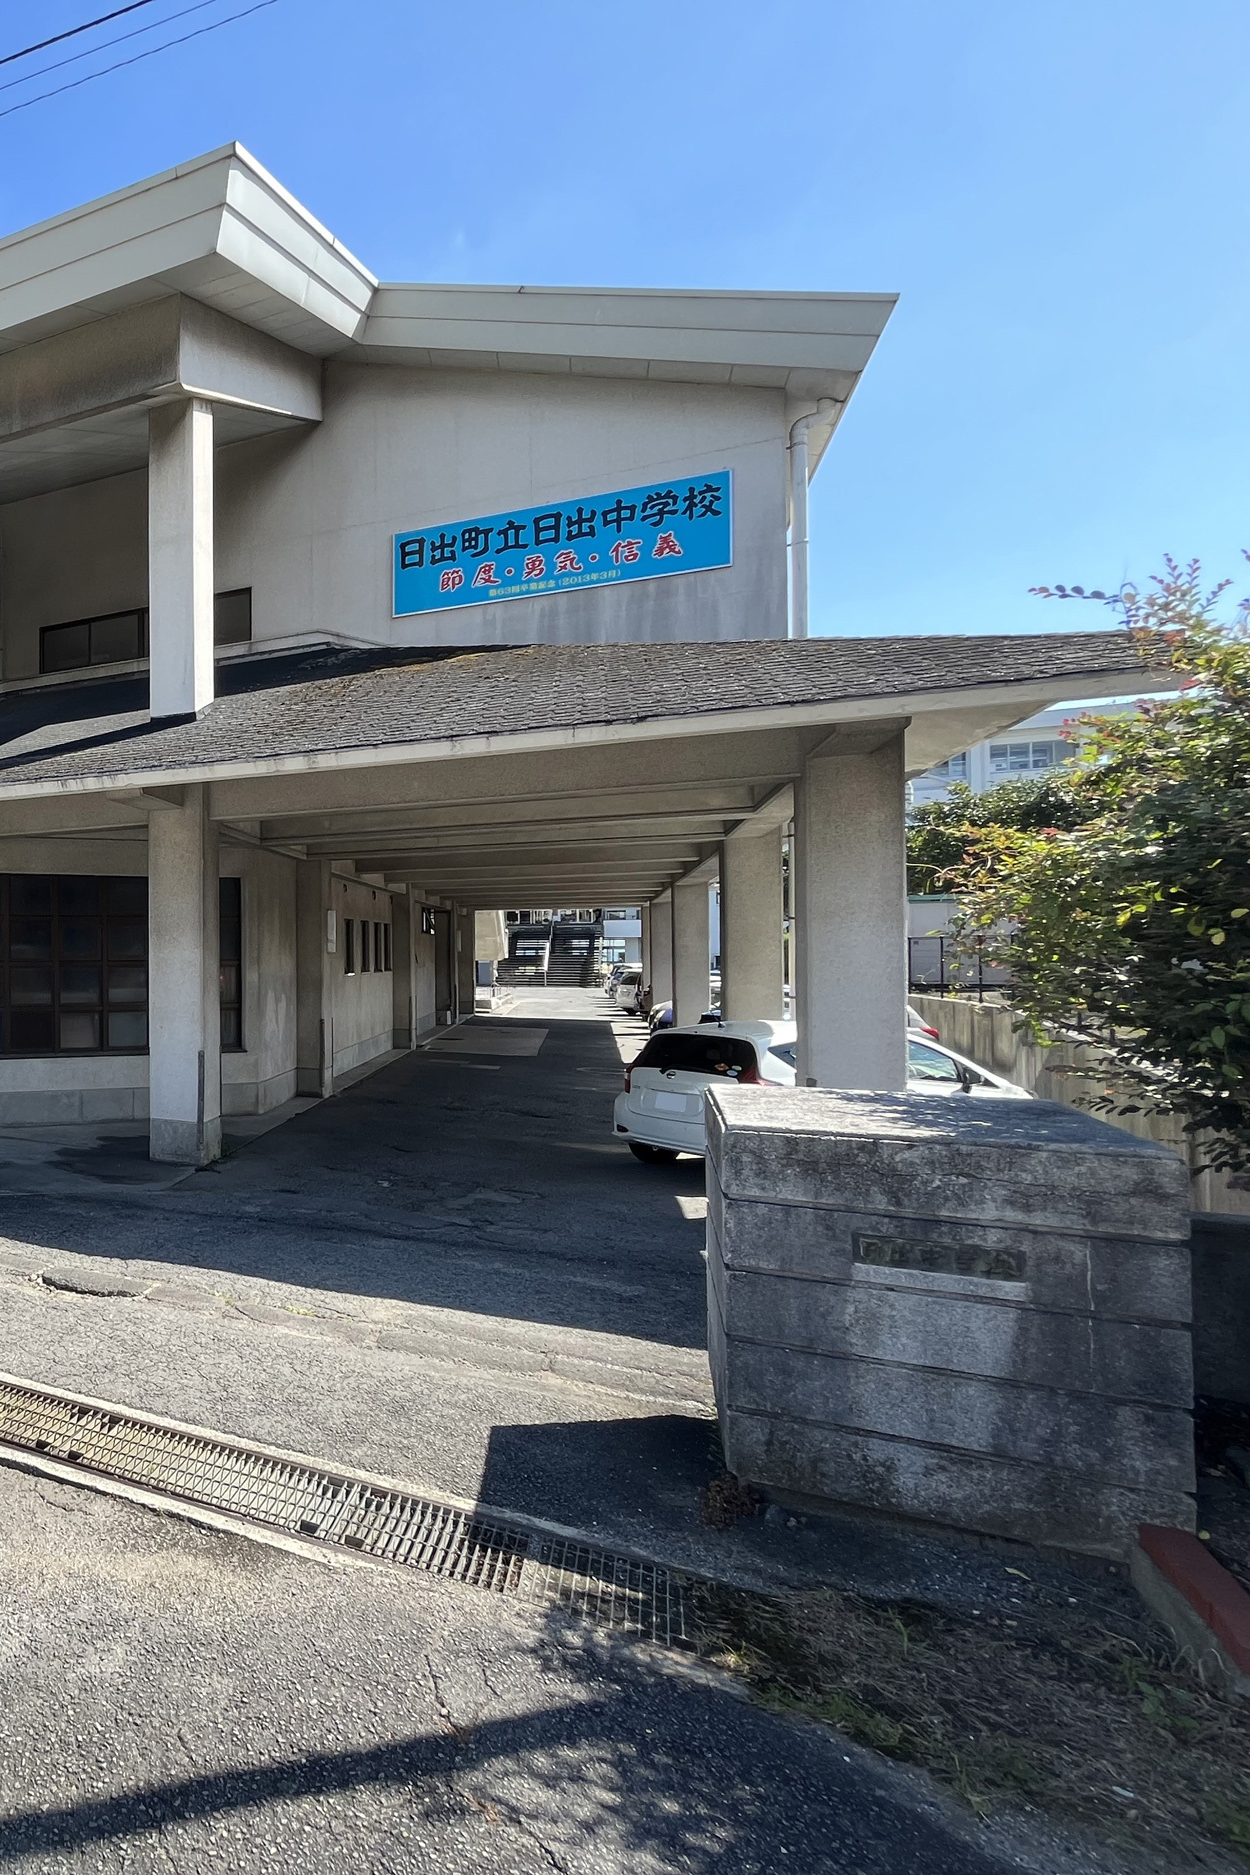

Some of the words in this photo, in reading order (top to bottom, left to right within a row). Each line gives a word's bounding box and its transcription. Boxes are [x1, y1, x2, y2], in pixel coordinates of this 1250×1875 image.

[399, 483, 723, 570] 日出町立日出中学校
